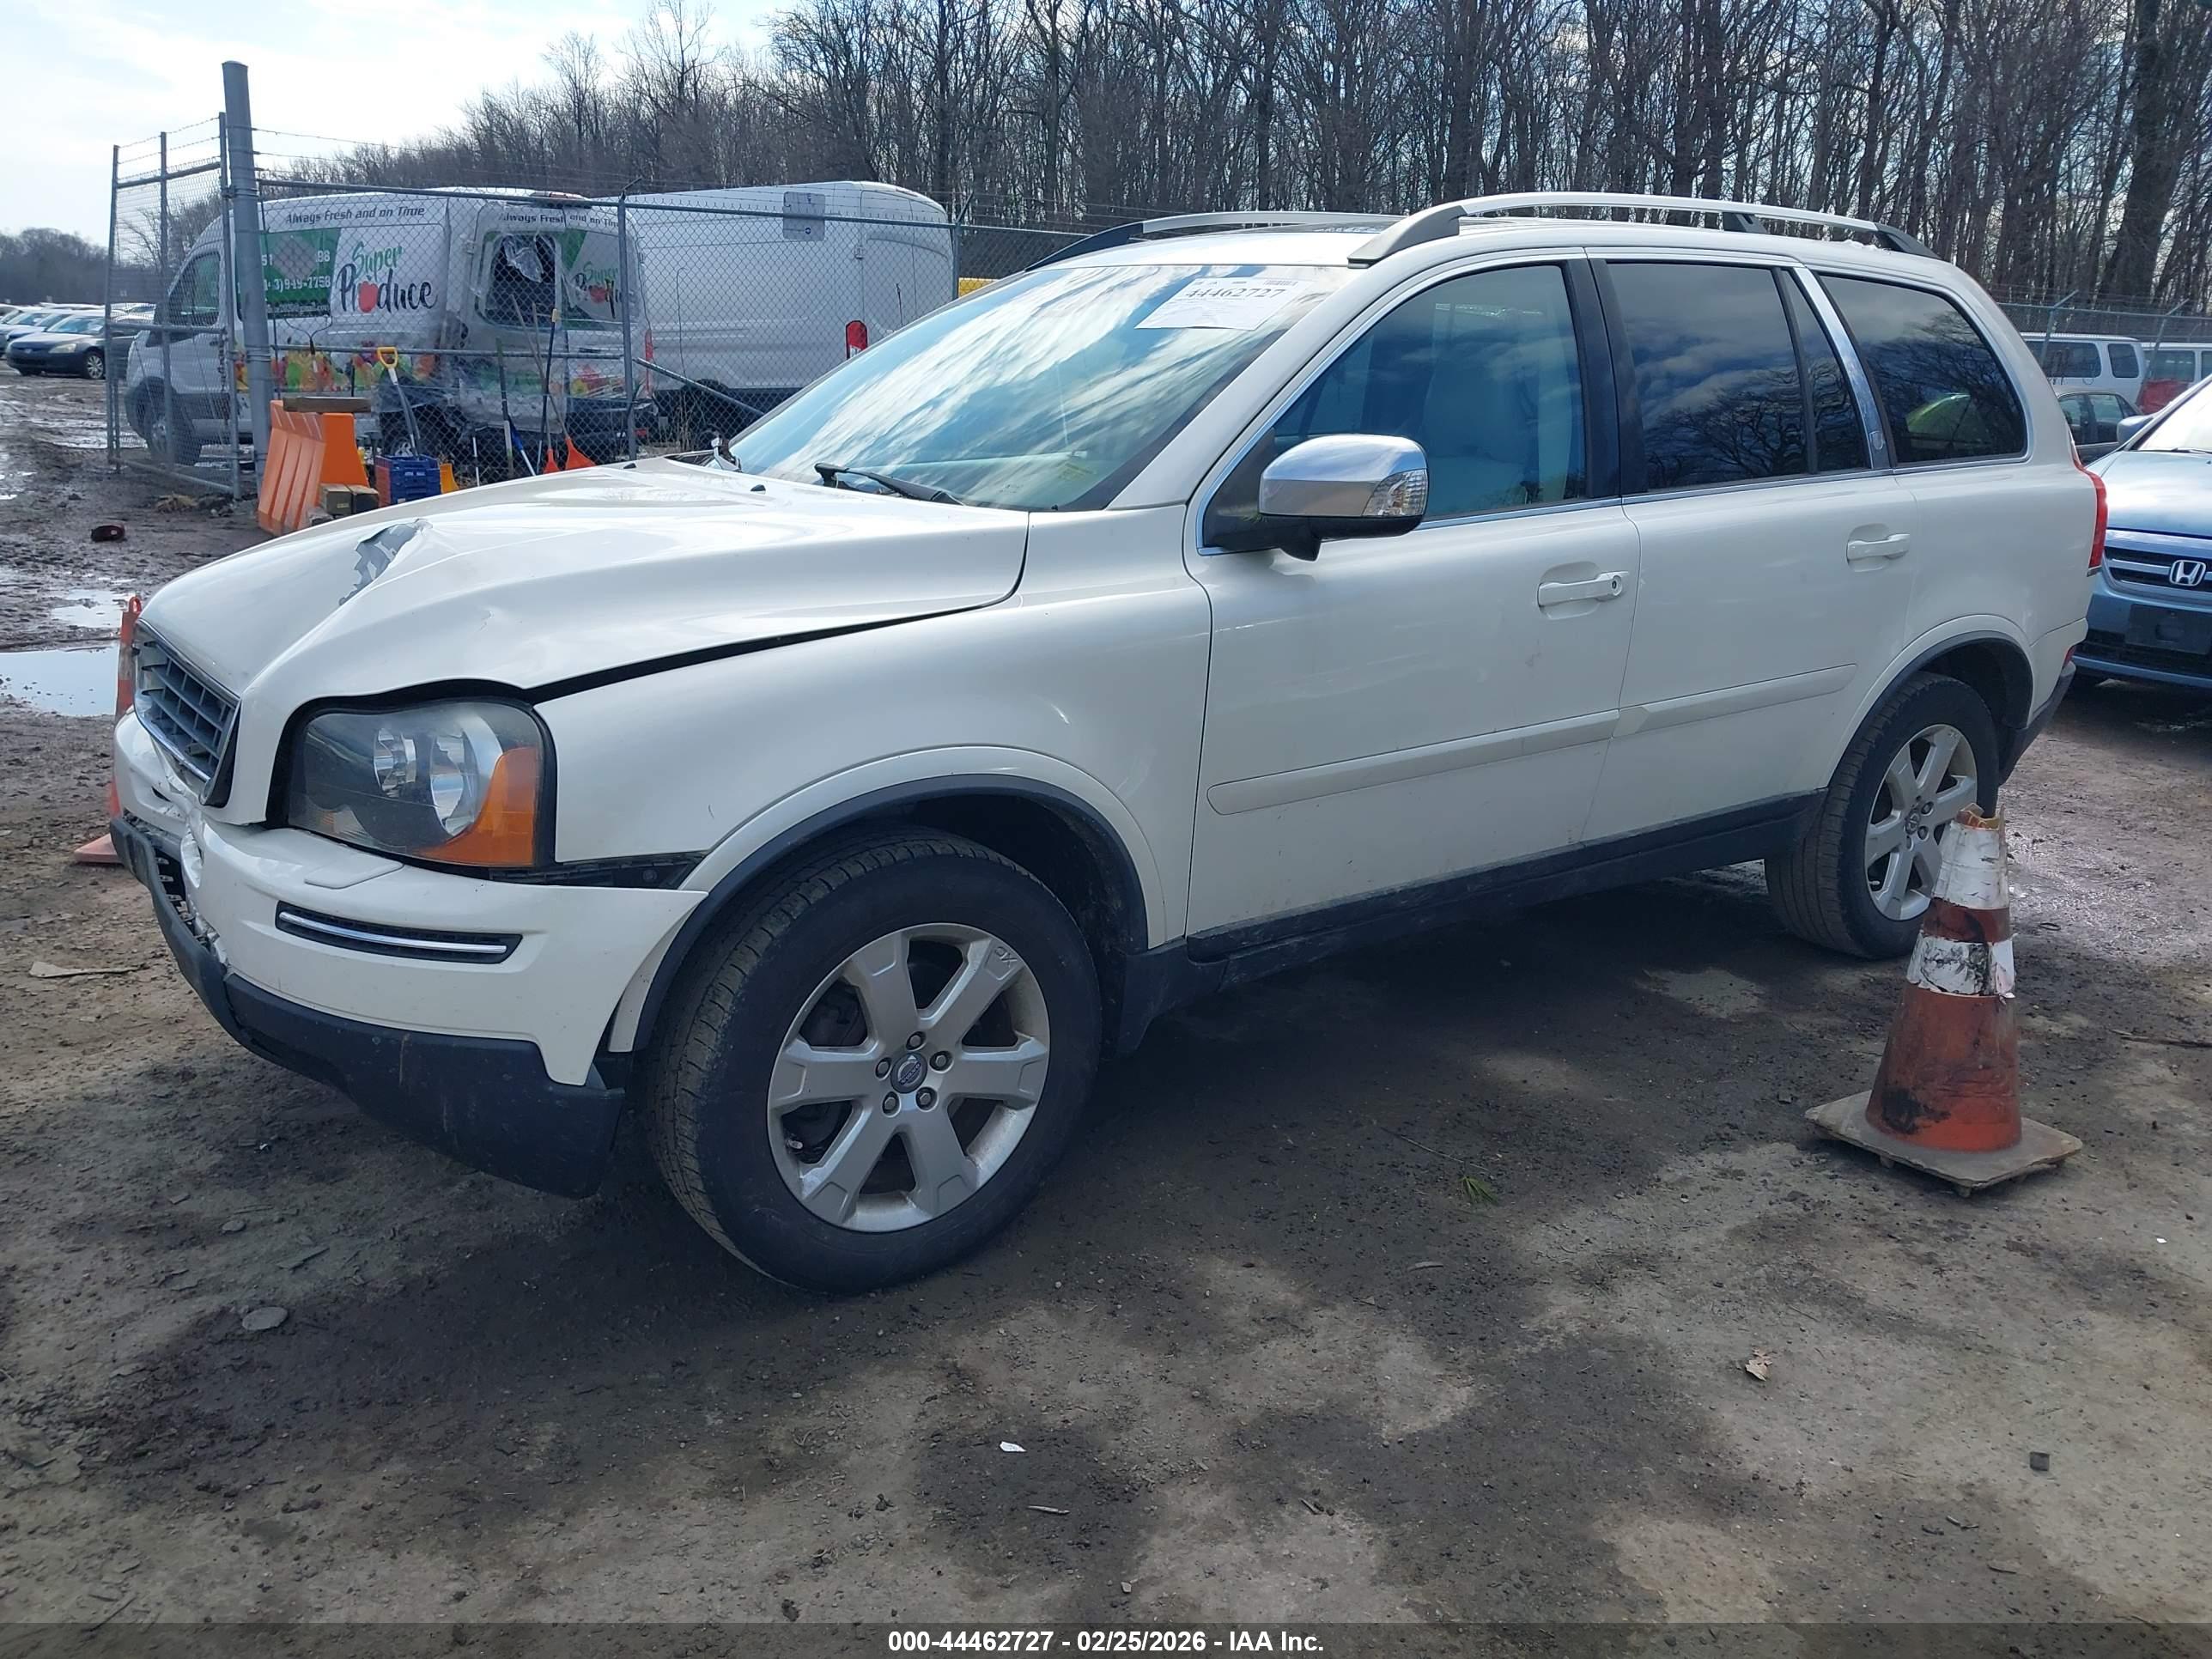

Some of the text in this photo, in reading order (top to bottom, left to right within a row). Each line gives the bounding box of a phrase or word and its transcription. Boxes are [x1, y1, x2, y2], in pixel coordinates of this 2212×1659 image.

[287, 206, 425, 224] Always Fresh and on Time
[352, 240, 403, 282] Super
[335, 263, 438, 314] Produce
[1185, 288, 1286, 298] 44462727
